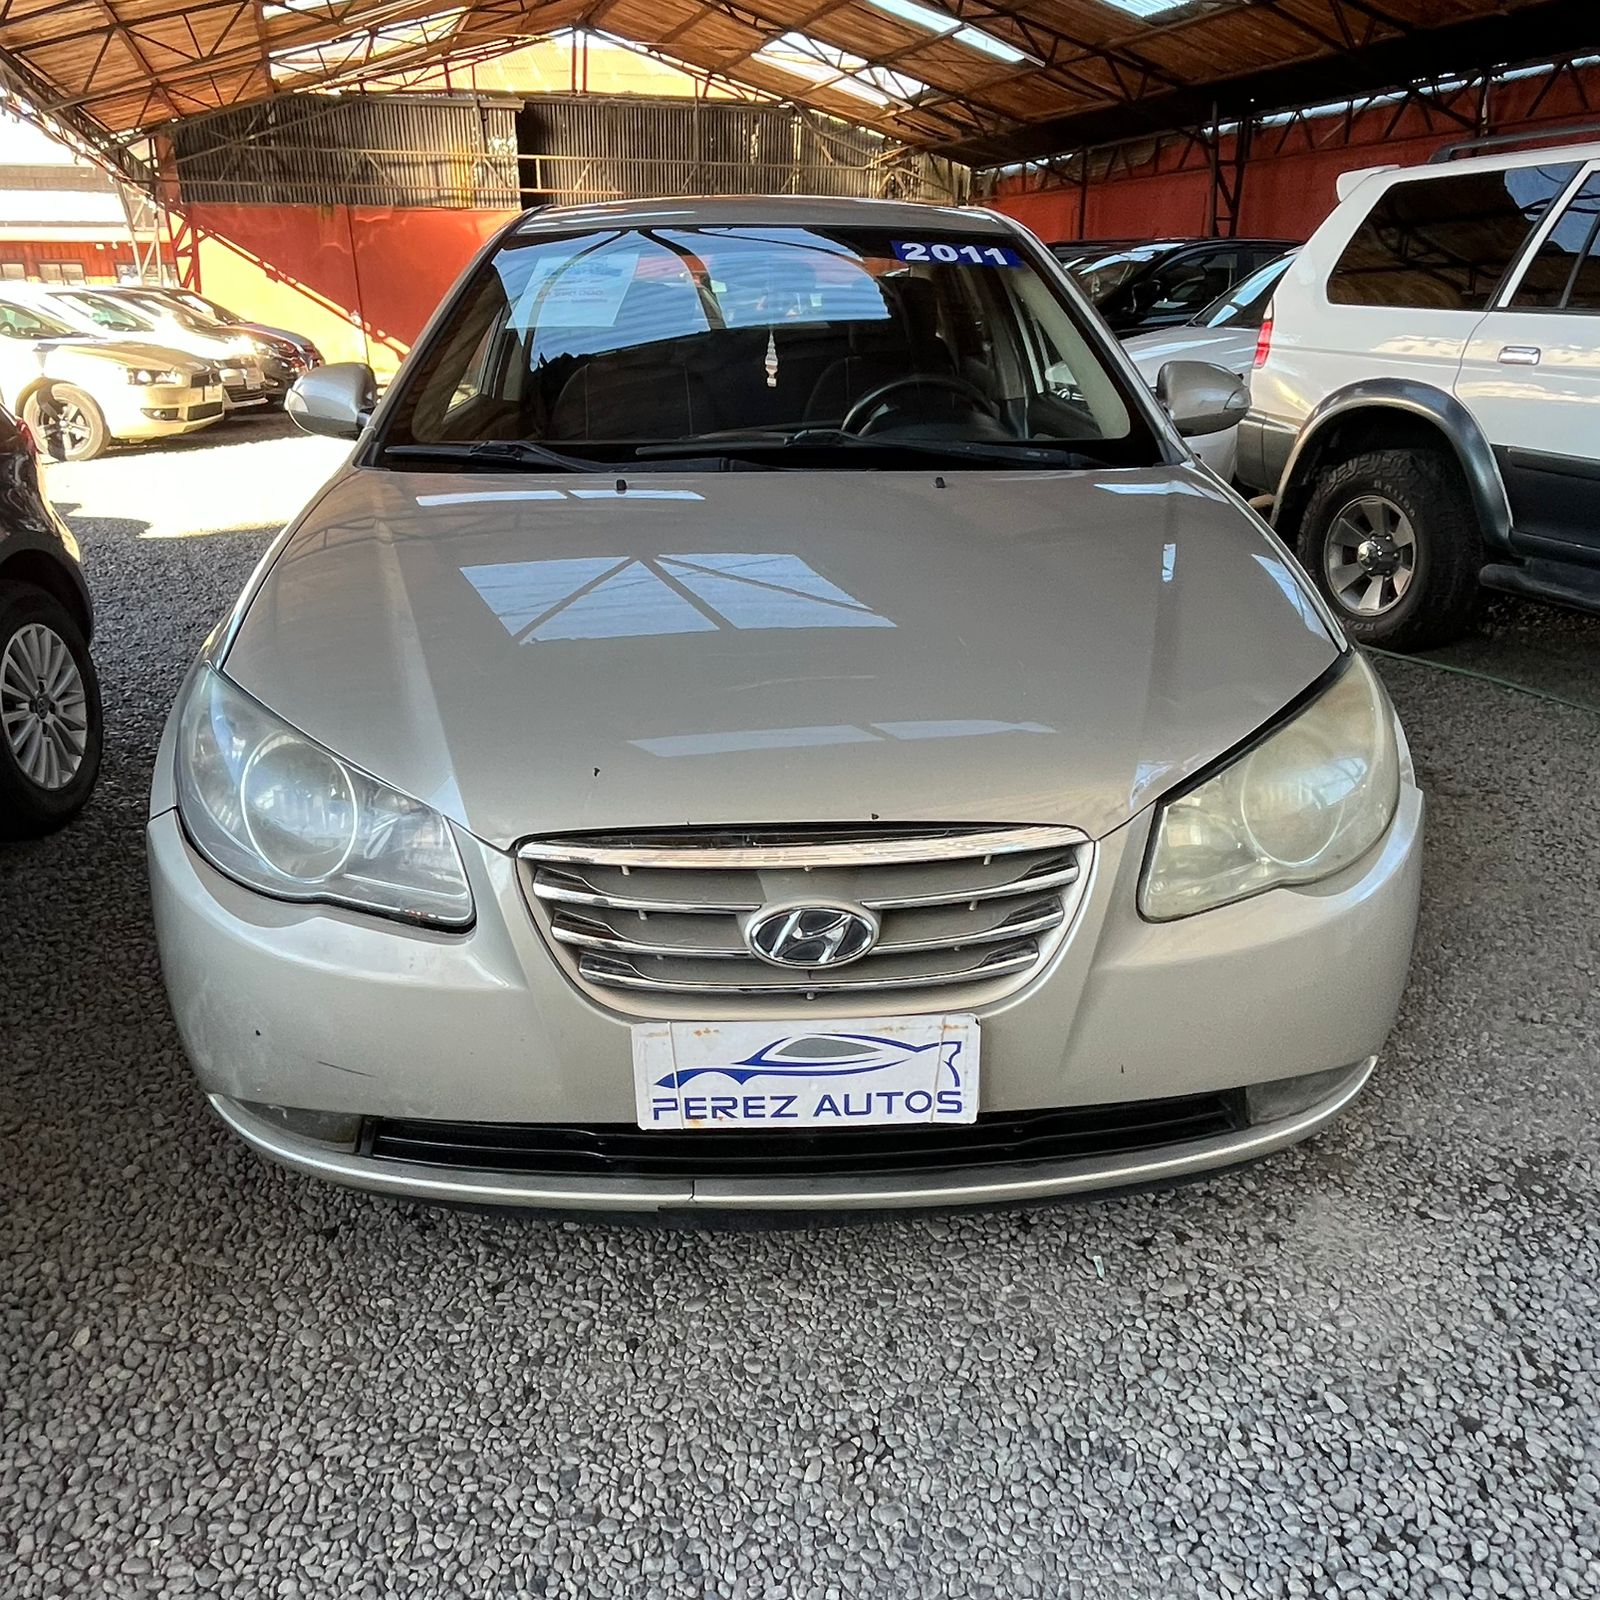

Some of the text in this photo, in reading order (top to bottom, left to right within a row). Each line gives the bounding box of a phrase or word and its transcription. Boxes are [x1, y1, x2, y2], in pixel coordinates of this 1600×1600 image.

[901, 242, 1008, 266] 2011
[652, 1090, 963, 1121] PEREZ AUTOS
